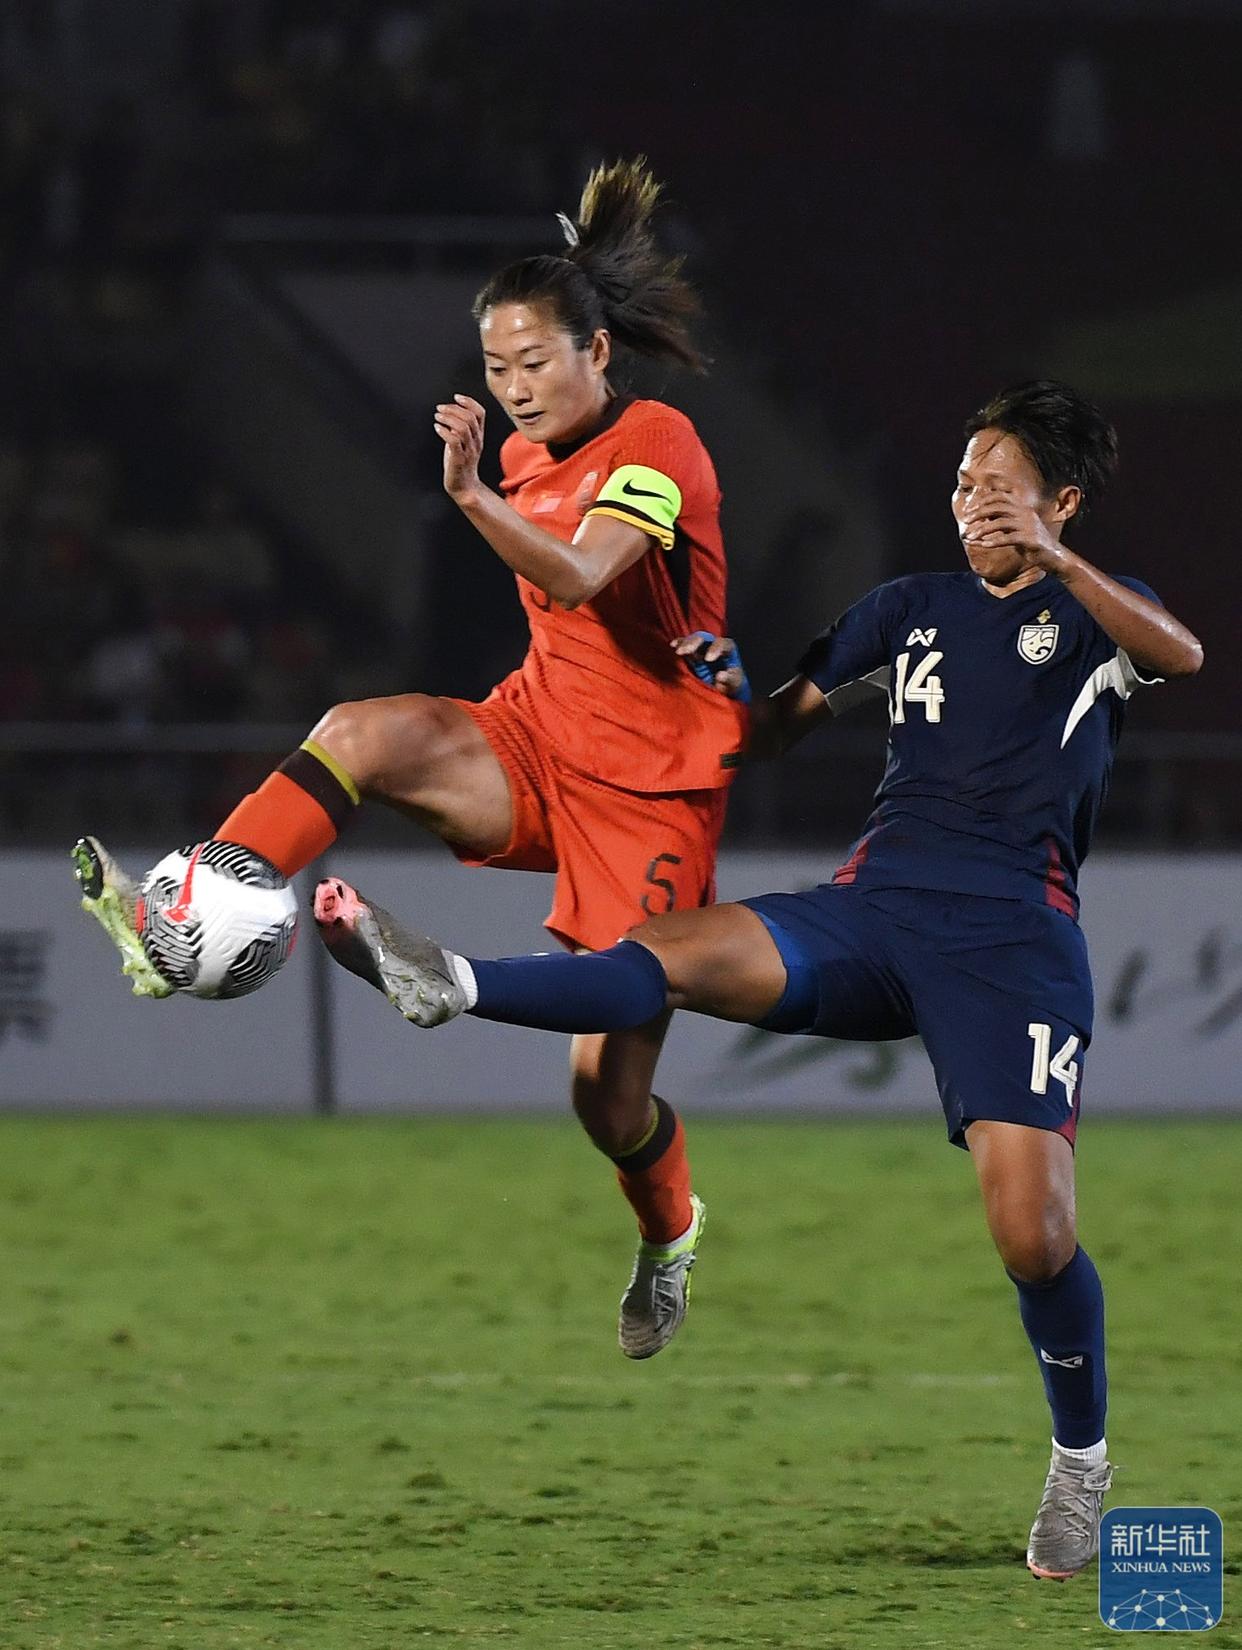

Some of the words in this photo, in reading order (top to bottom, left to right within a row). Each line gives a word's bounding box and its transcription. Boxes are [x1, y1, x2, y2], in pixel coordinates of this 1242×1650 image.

[893, 651, 945, 724] 14
[640, 852, 682, 917] 5
[1028, 1022, 1080, 1108] 14
